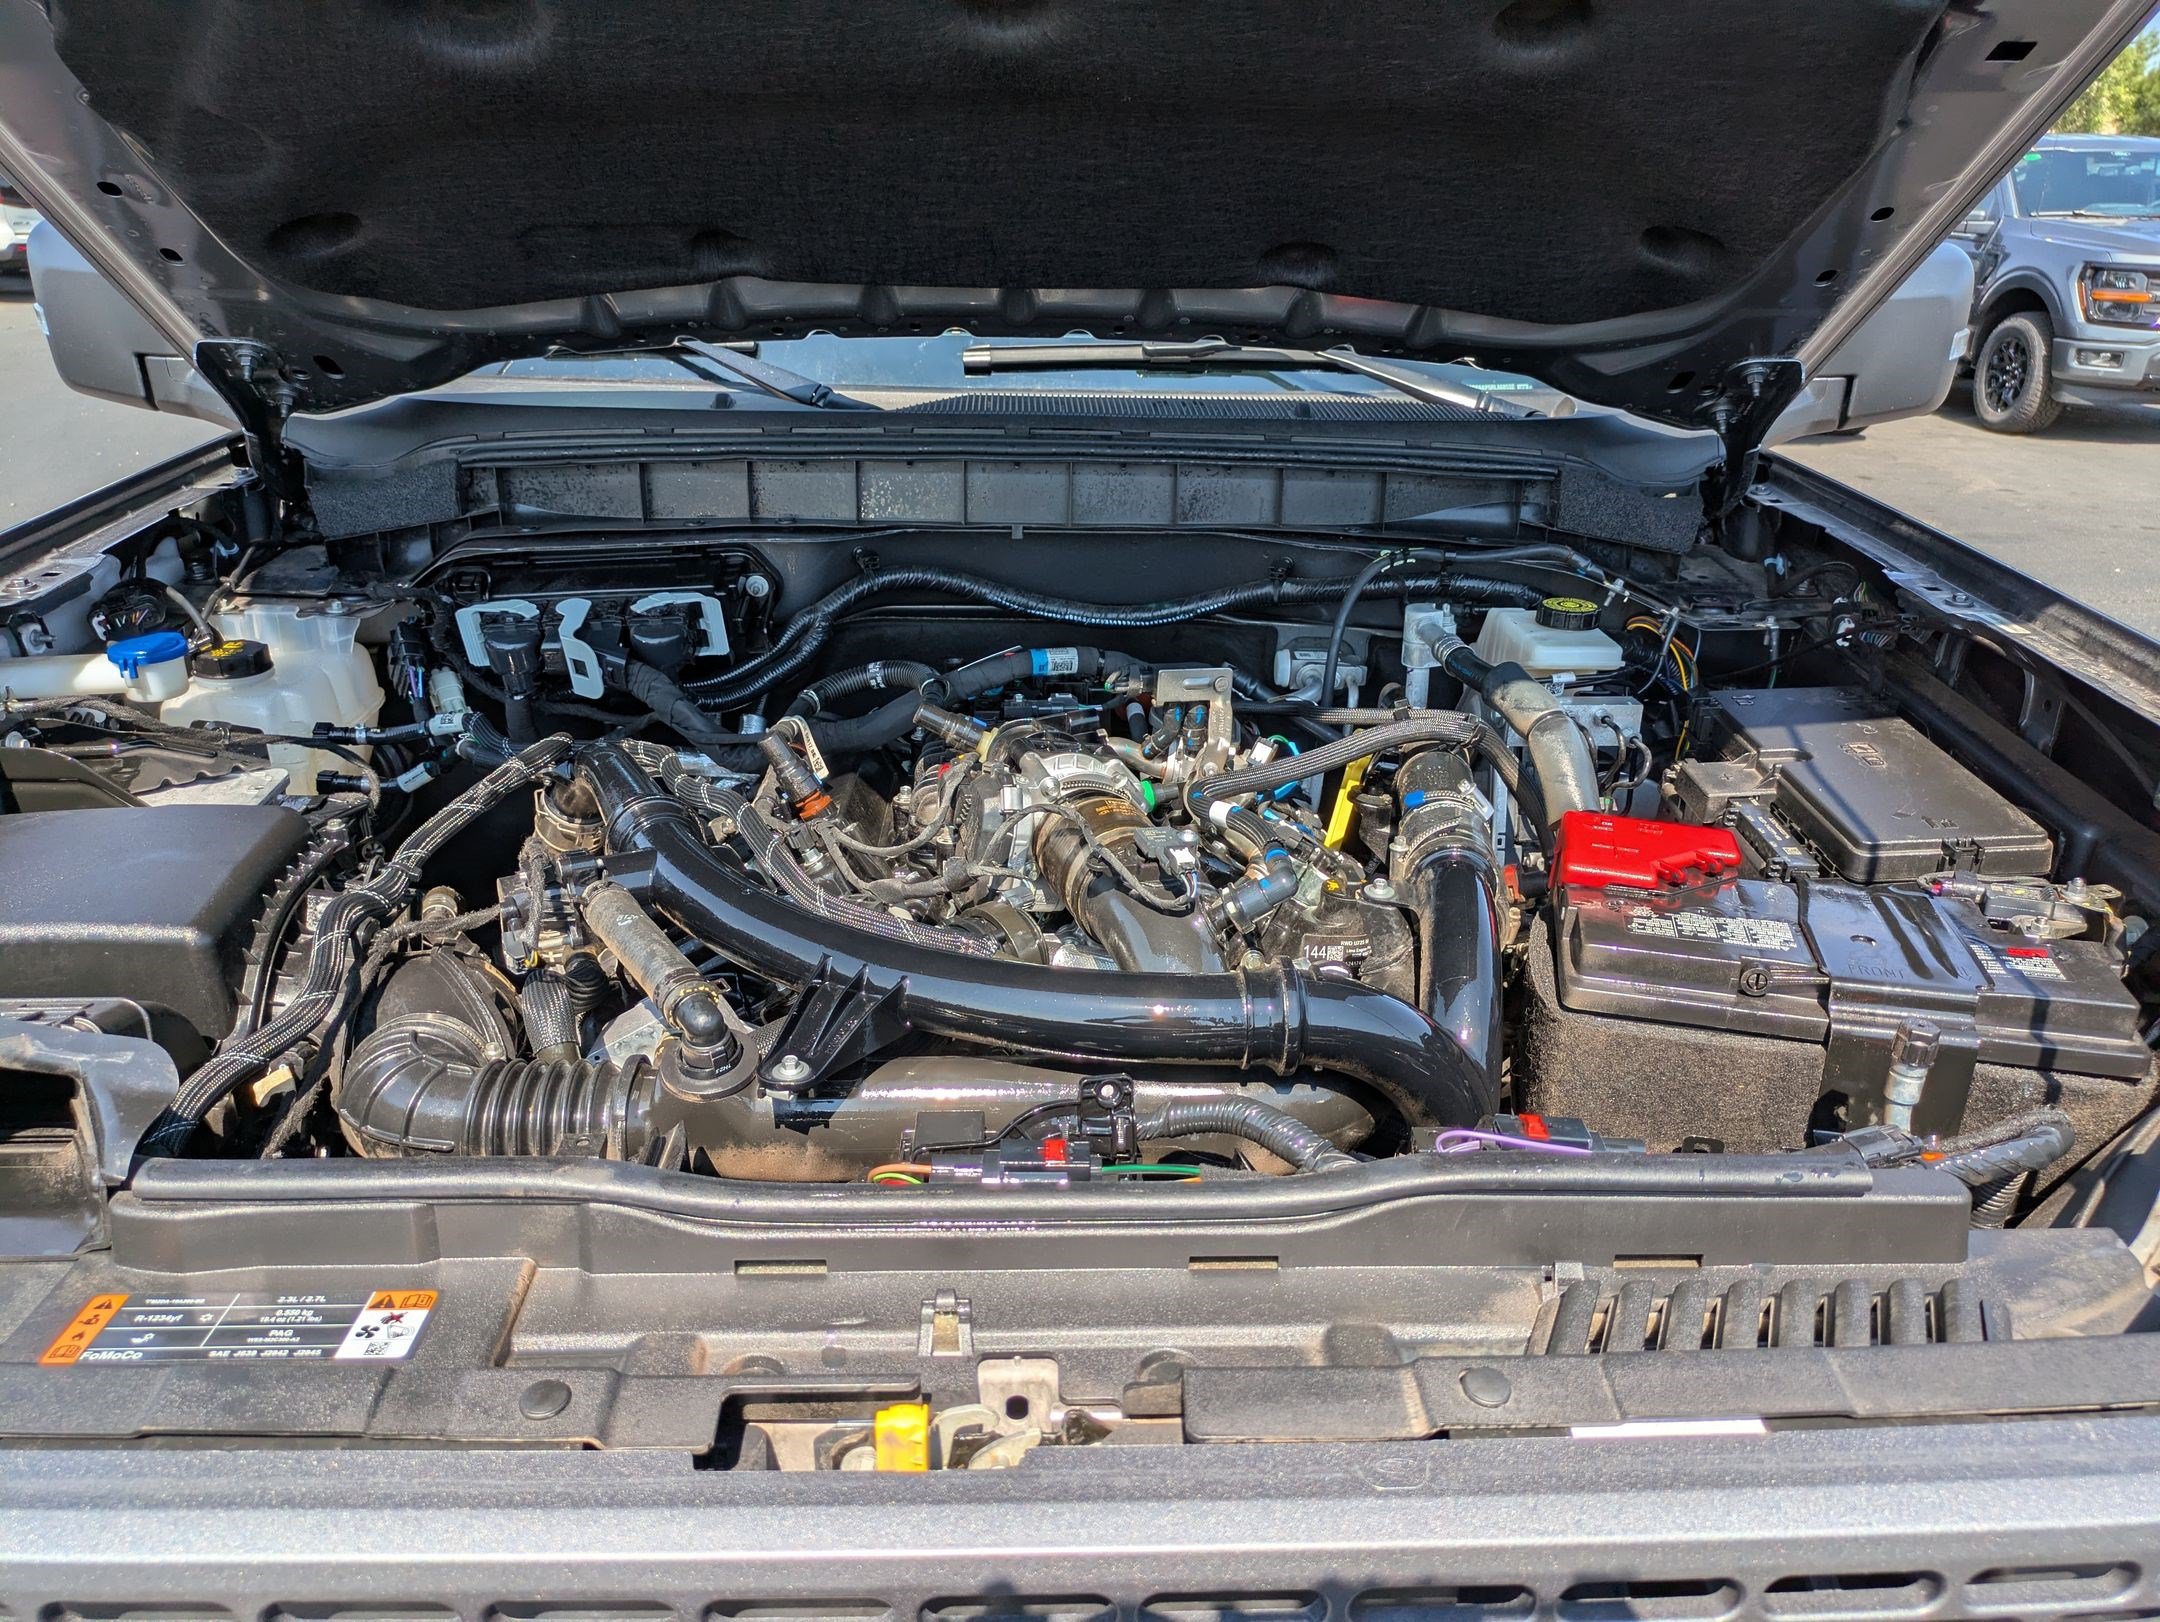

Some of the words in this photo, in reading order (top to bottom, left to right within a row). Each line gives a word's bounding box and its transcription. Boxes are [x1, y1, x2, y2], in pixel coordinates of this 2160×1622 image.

[1303, 944, 1327, 959] 144
[134, 1313, 184, 1323] R-1234yf
[269, 1329, 294, 1337] PAG
[79, 1350, 143, 1360] FoMoCo
